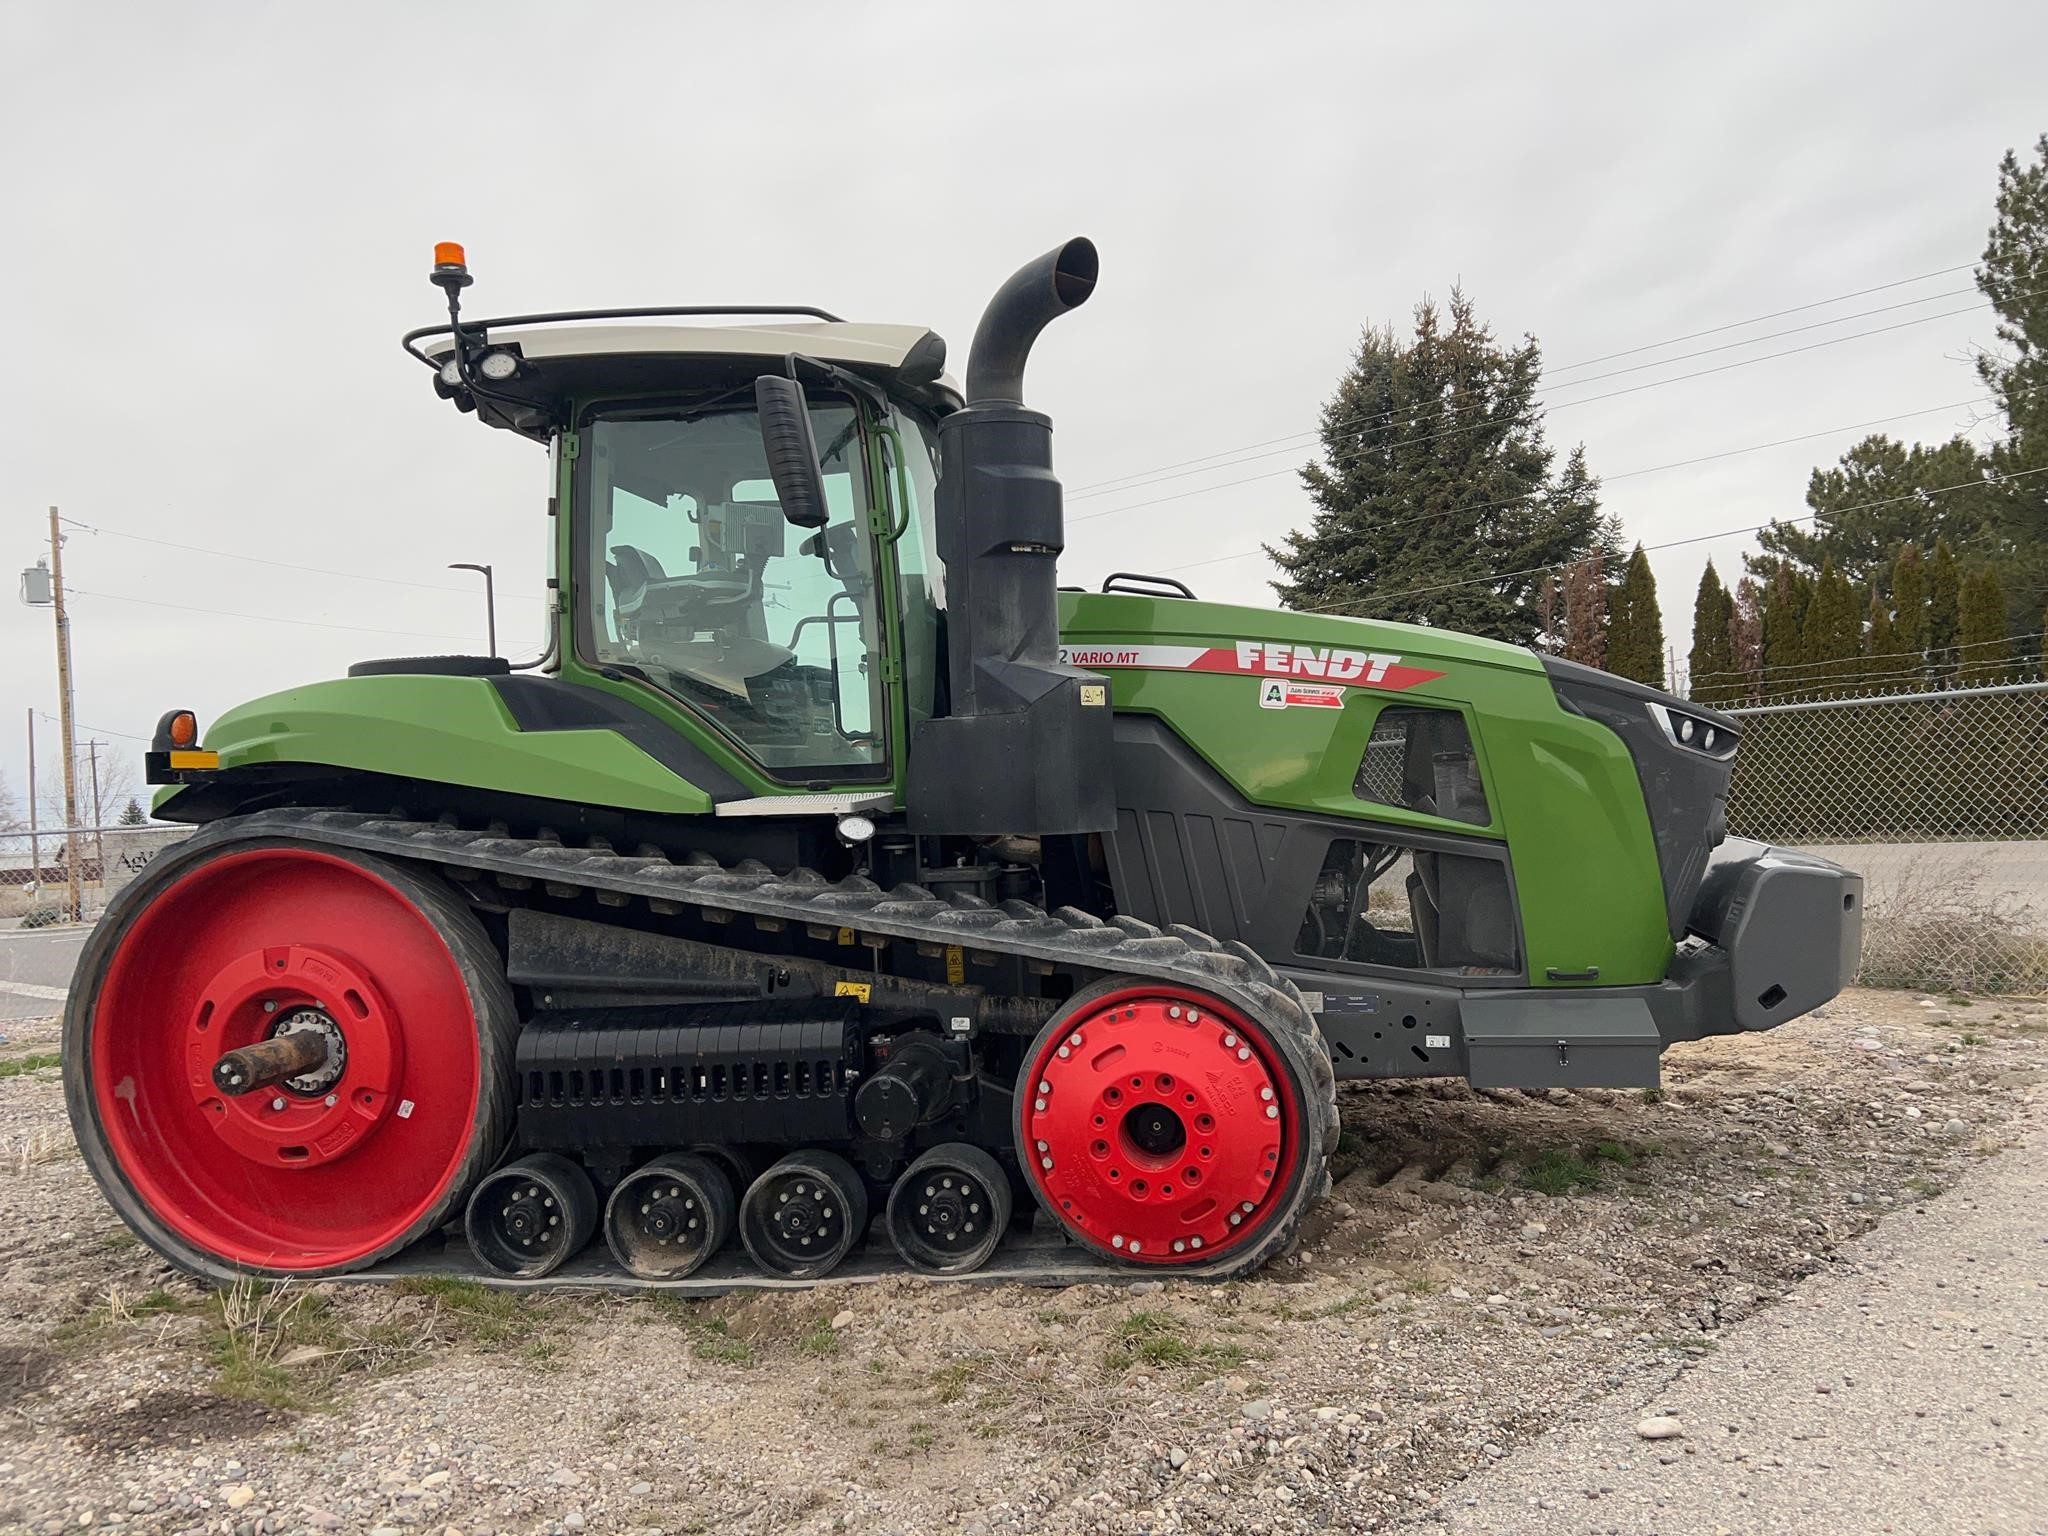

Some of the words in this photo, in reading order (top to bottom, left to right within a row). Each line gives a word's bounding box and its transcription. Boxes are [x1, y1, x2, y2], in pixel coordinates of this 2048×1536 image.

[1059, 650, 1068, 663] 2
[1072, 652, 1114, 663] VARIO
[1117, 652, 1139, 663] MT
[1236, 641, 1401, 682] FENDT
